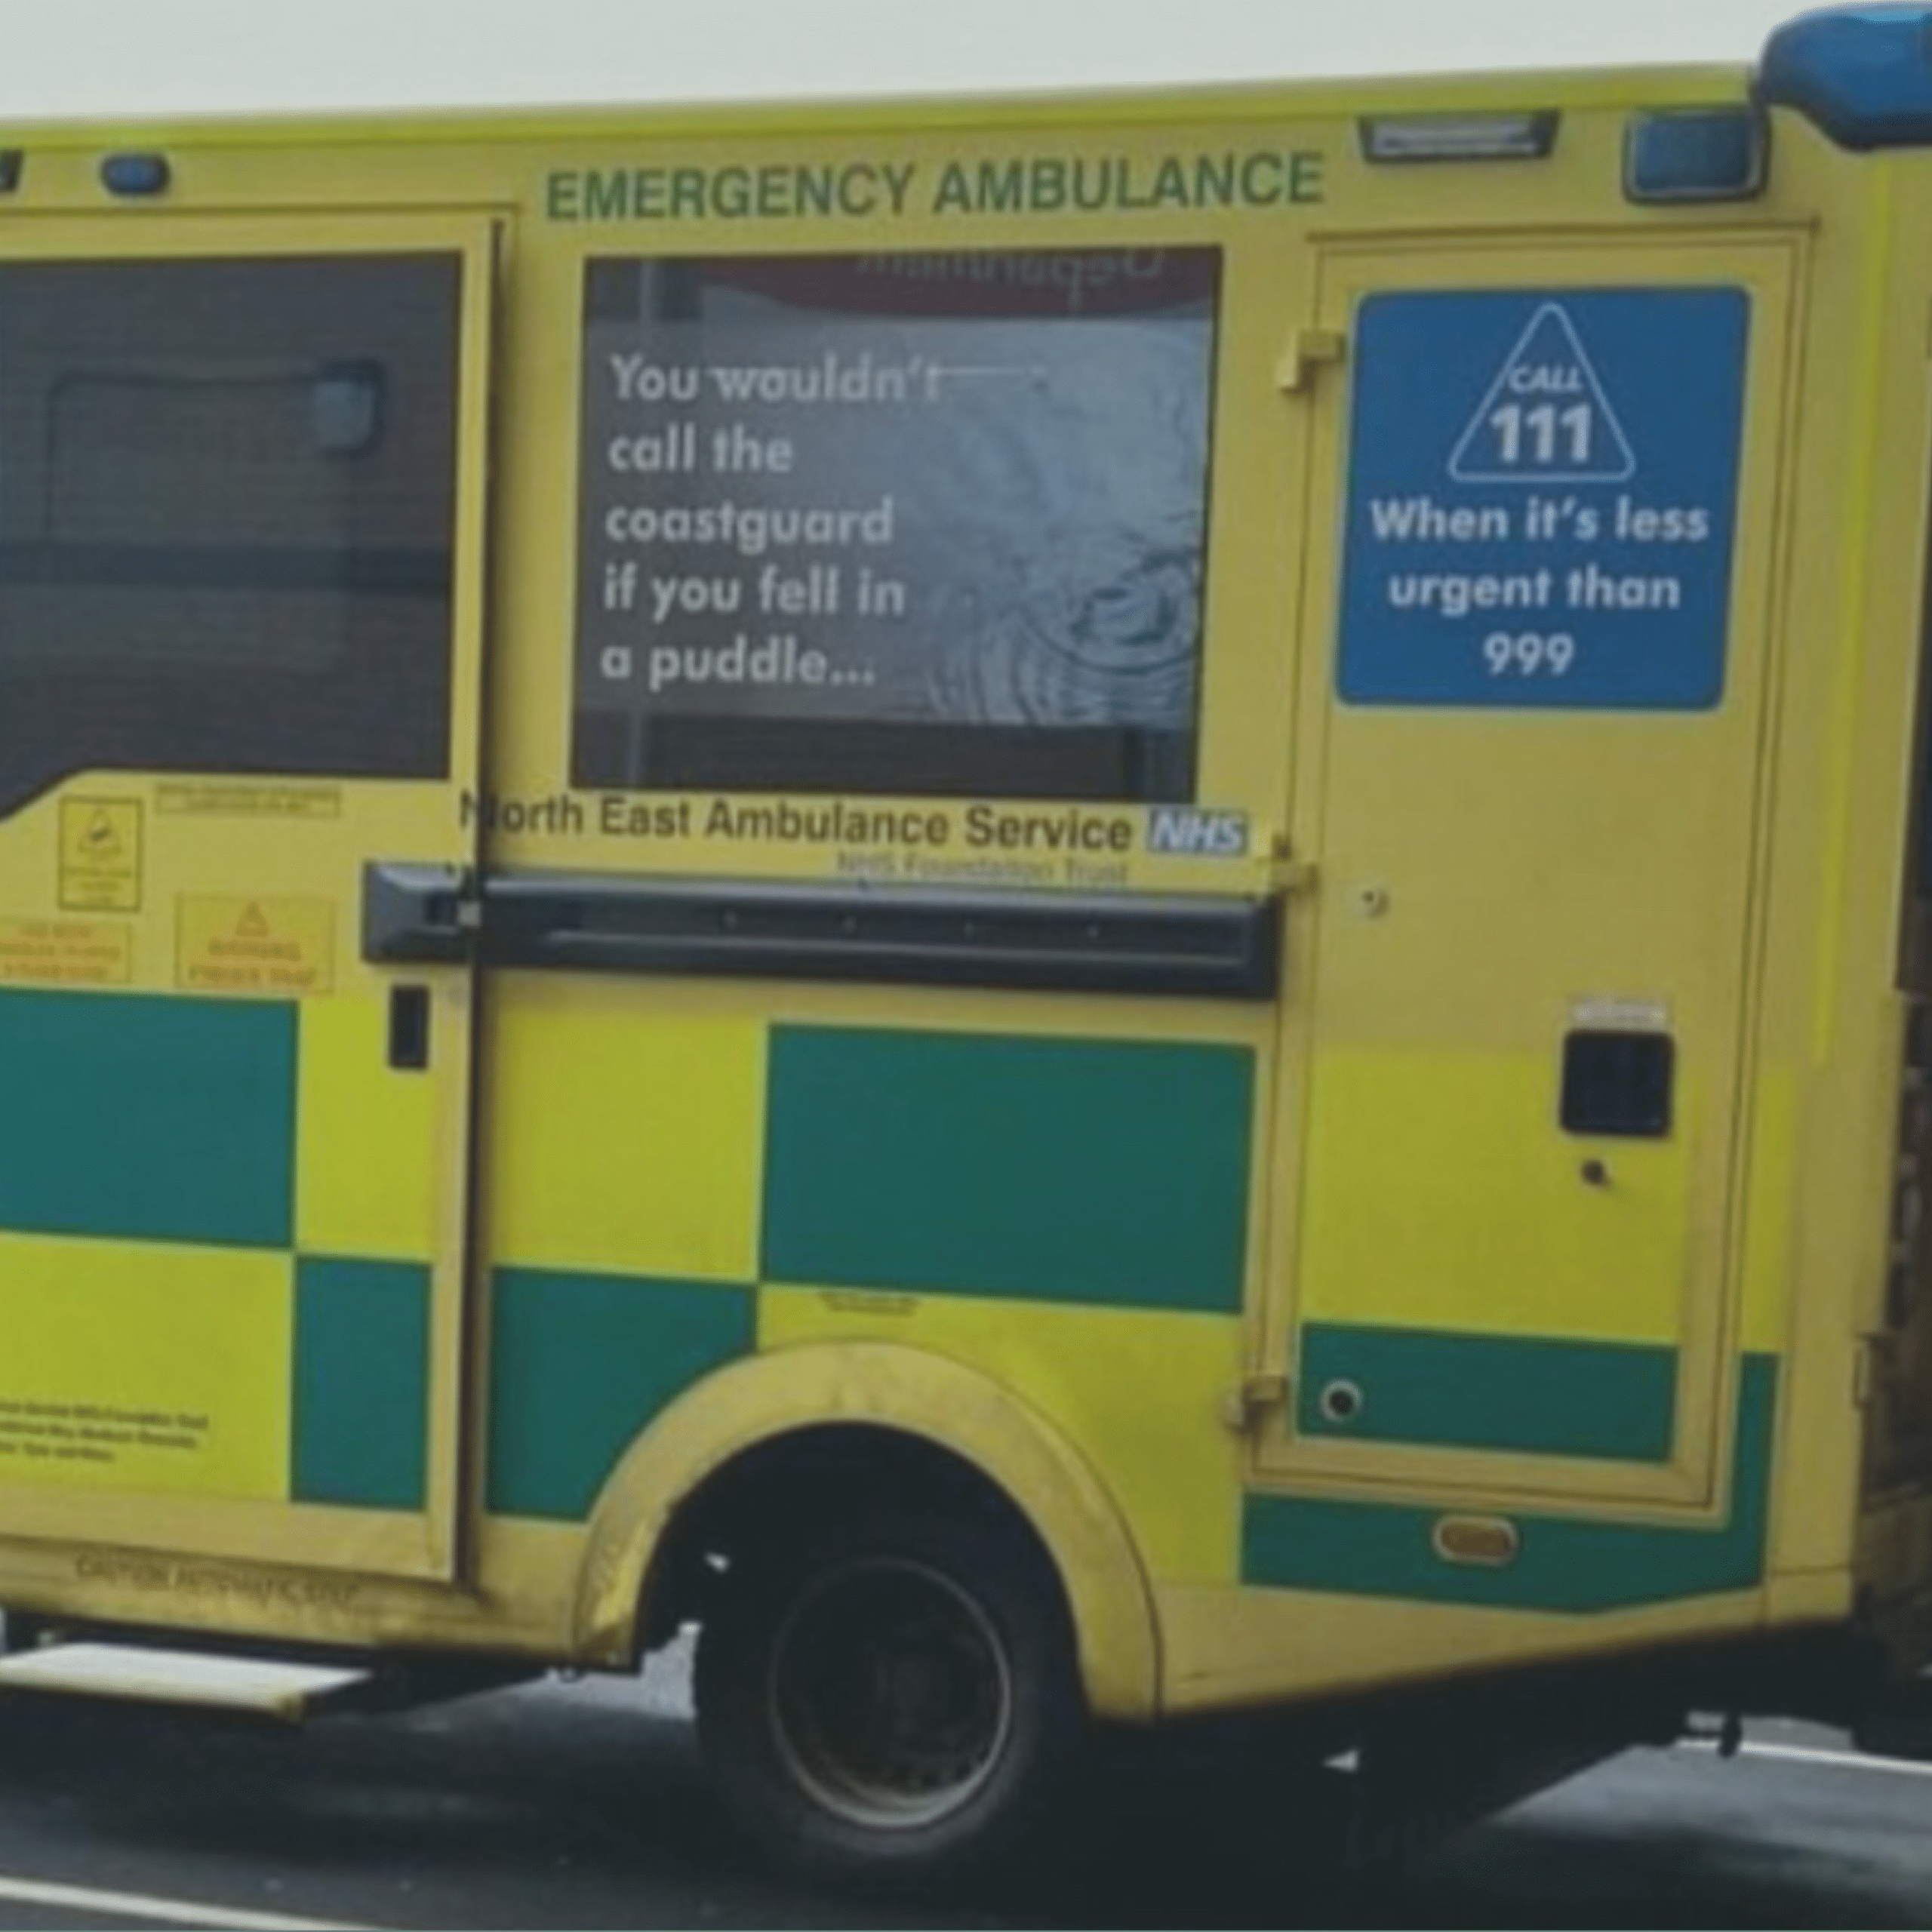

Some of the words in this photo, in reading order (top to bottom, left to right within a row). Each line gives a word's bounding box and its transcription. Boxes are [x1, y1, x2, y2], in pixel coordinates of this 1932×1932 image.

[546, 165, 915, 221] EMERGENCY
[934, 152, 1324, 214] AMBULANCE
[610, 353, 699, 401] You
[712, 350, 941, 401] wouldn't
[1509, 365, 1583, 393] CALL
[608, 422, 696, 472] call
[714, 422, 794, 472] the
[1489, 404, 1592, 463] 111
[605, 495, 893, 555] coastguard
[1371, 496, 1508, 541] When
[1526, 495, 1598, 541] it's
[1614, 494, 1710, 542] less
[605, 561, 637, 611] if
[652, 577, 742, 624] you
[758, 563, 839, 614] fell
[858, 568, 906, 617] in
[1389, 568, 1552, 618] urgent
[1567, 562, 1681, 610] than
[603, 645, 632, 679] a
[648, 632, 875, 694] puddle...
[1484, 632, 1575, 676] 999
[460, 790, 584, 833] North
[603, 795, 691, 838] East
[703, 796, 949, 846] Ambulance
[964, 804, 1131, 851] Service
[1150, 809, 1245, 854] NHS
